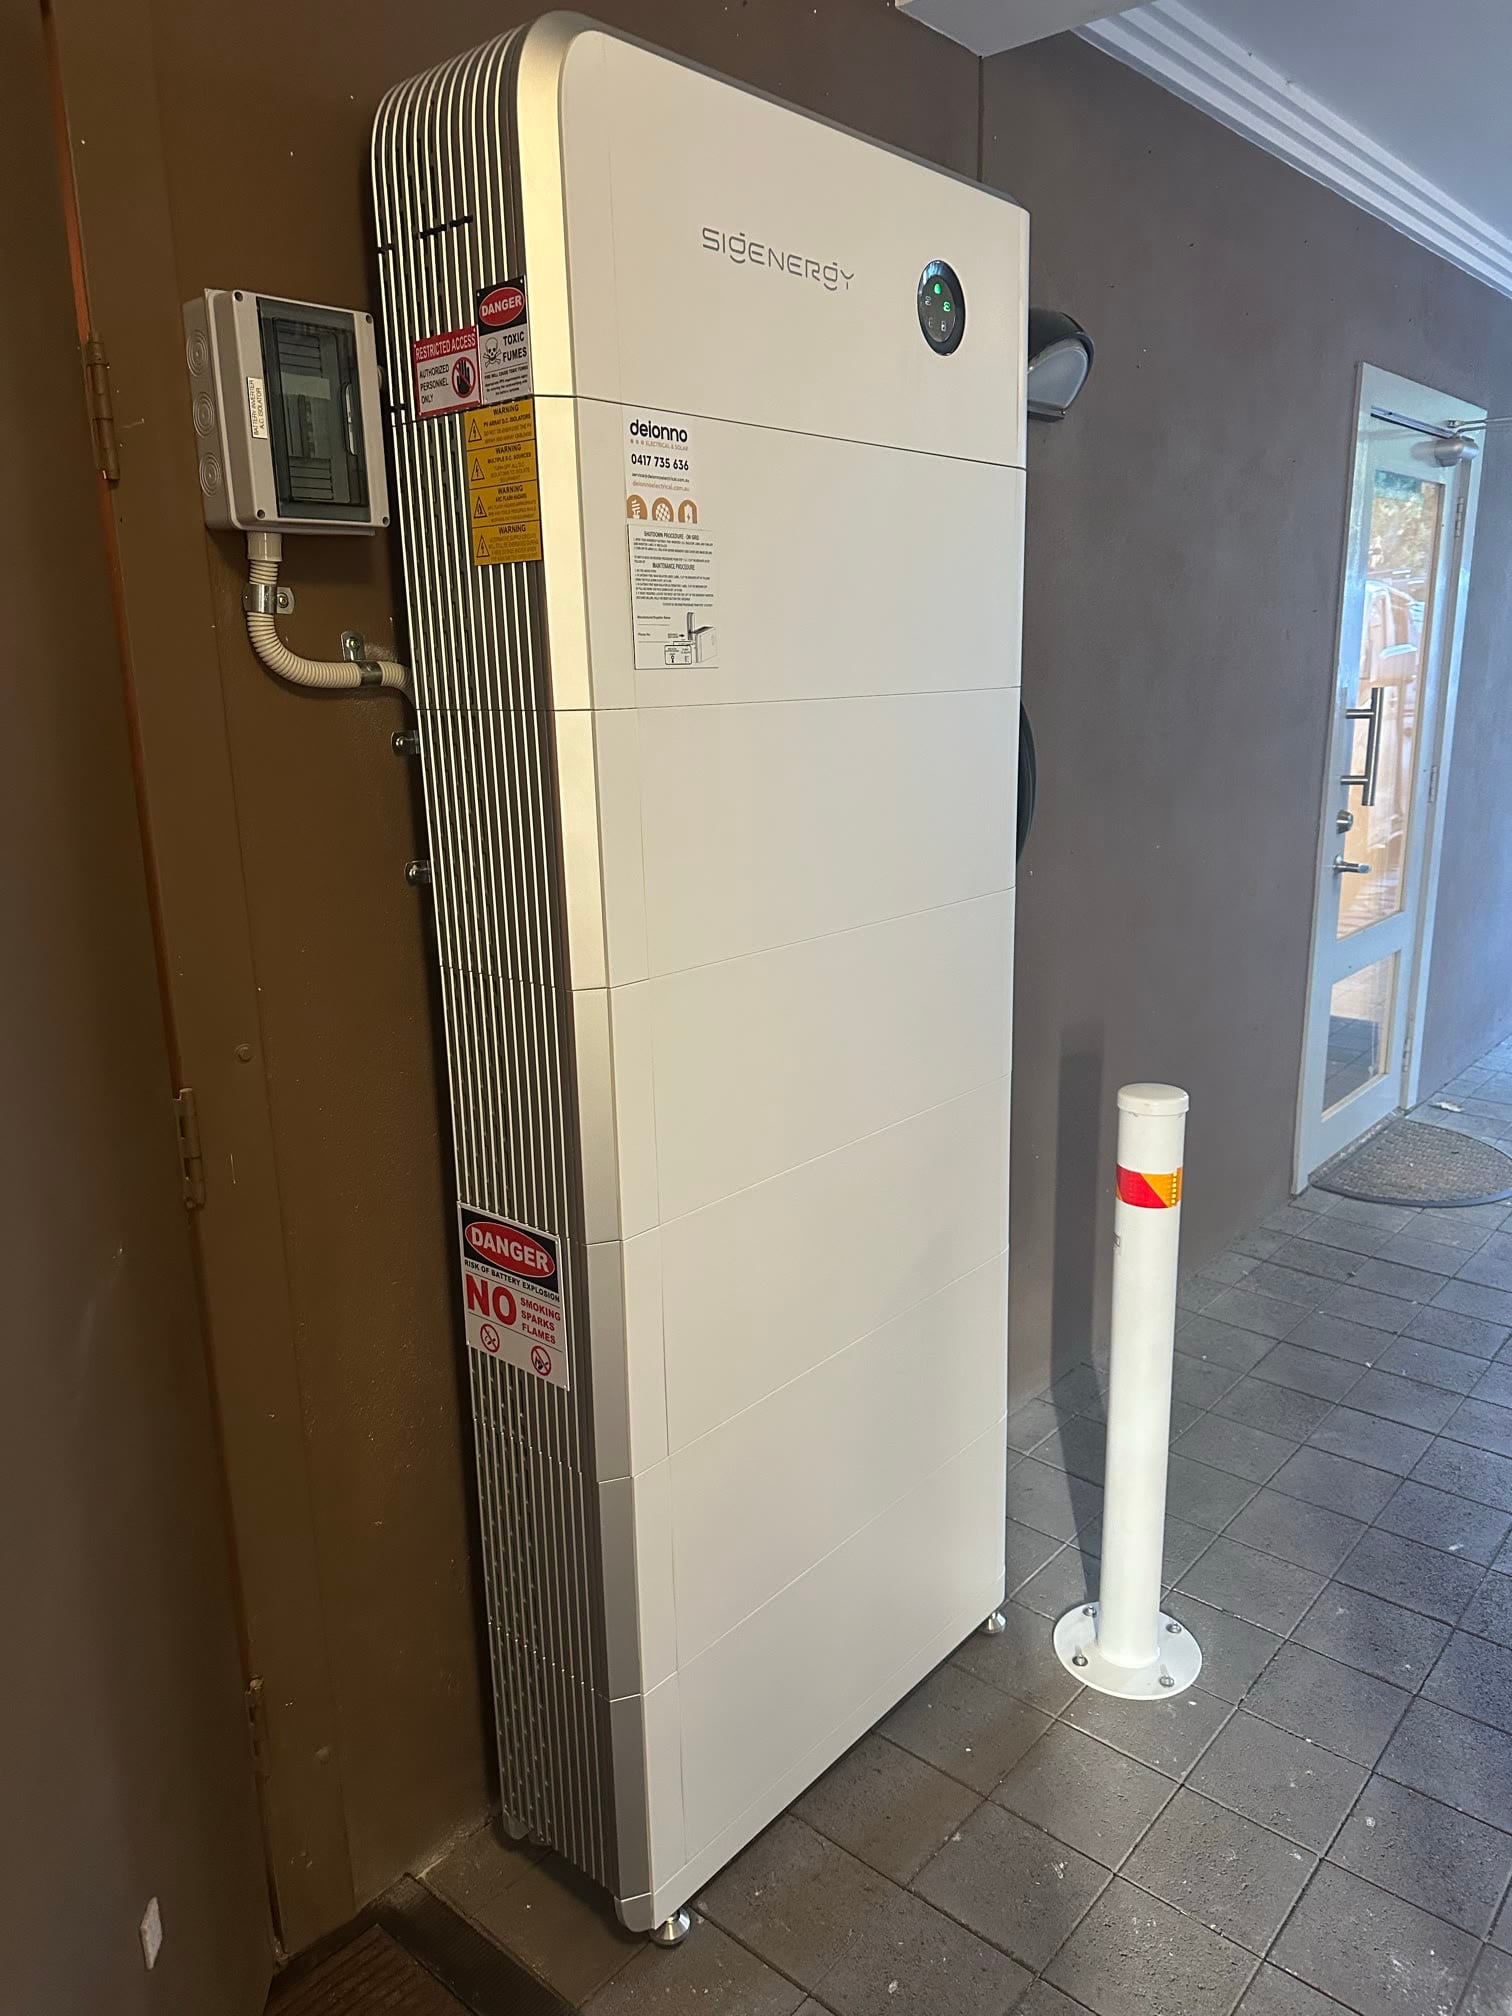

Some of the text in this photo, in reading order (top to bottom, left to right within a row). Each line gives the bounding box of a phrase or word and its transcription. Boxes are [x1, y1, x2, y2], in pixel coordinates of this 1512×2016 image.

[702, 227, 854, 291] SIGENERGY
[481, 294, 522, 316] DANGER
[415, 333, 476, 361] RESTRICTED ACCESS
[502, 331, 525, 346] TOXIC
[502, 347, 528, 362] FUMES
[419, 363, 450, 379] AUTHORIZED
[420, 378, 449, 391] PERSONNEL
[421, 393, 434, 404] ONLY
[492, 404, 519, 416] WARNING
[630, 418, 688, 442] deionno
[496, 444, 522, 454] WARNING
[631, 453, 689, 470] 0417 735 636
[497, 484, 524, 494] WARNING
[498, 524, 526, 534] WARNING
[652, 562, 676, 570] MAINTENANCE
[471, 1226, 550, 1274] DANGER
[464, 1259, 560, 1304] RISK OF BATTERY EXPLOSION
[466, 1274, 518, 1326] NO
[520, 1296, 561, 1322] SMOKING
[521, 1310, 555, 1332] SPARKS
[522, 1322, 556, 1344] FLAMES
